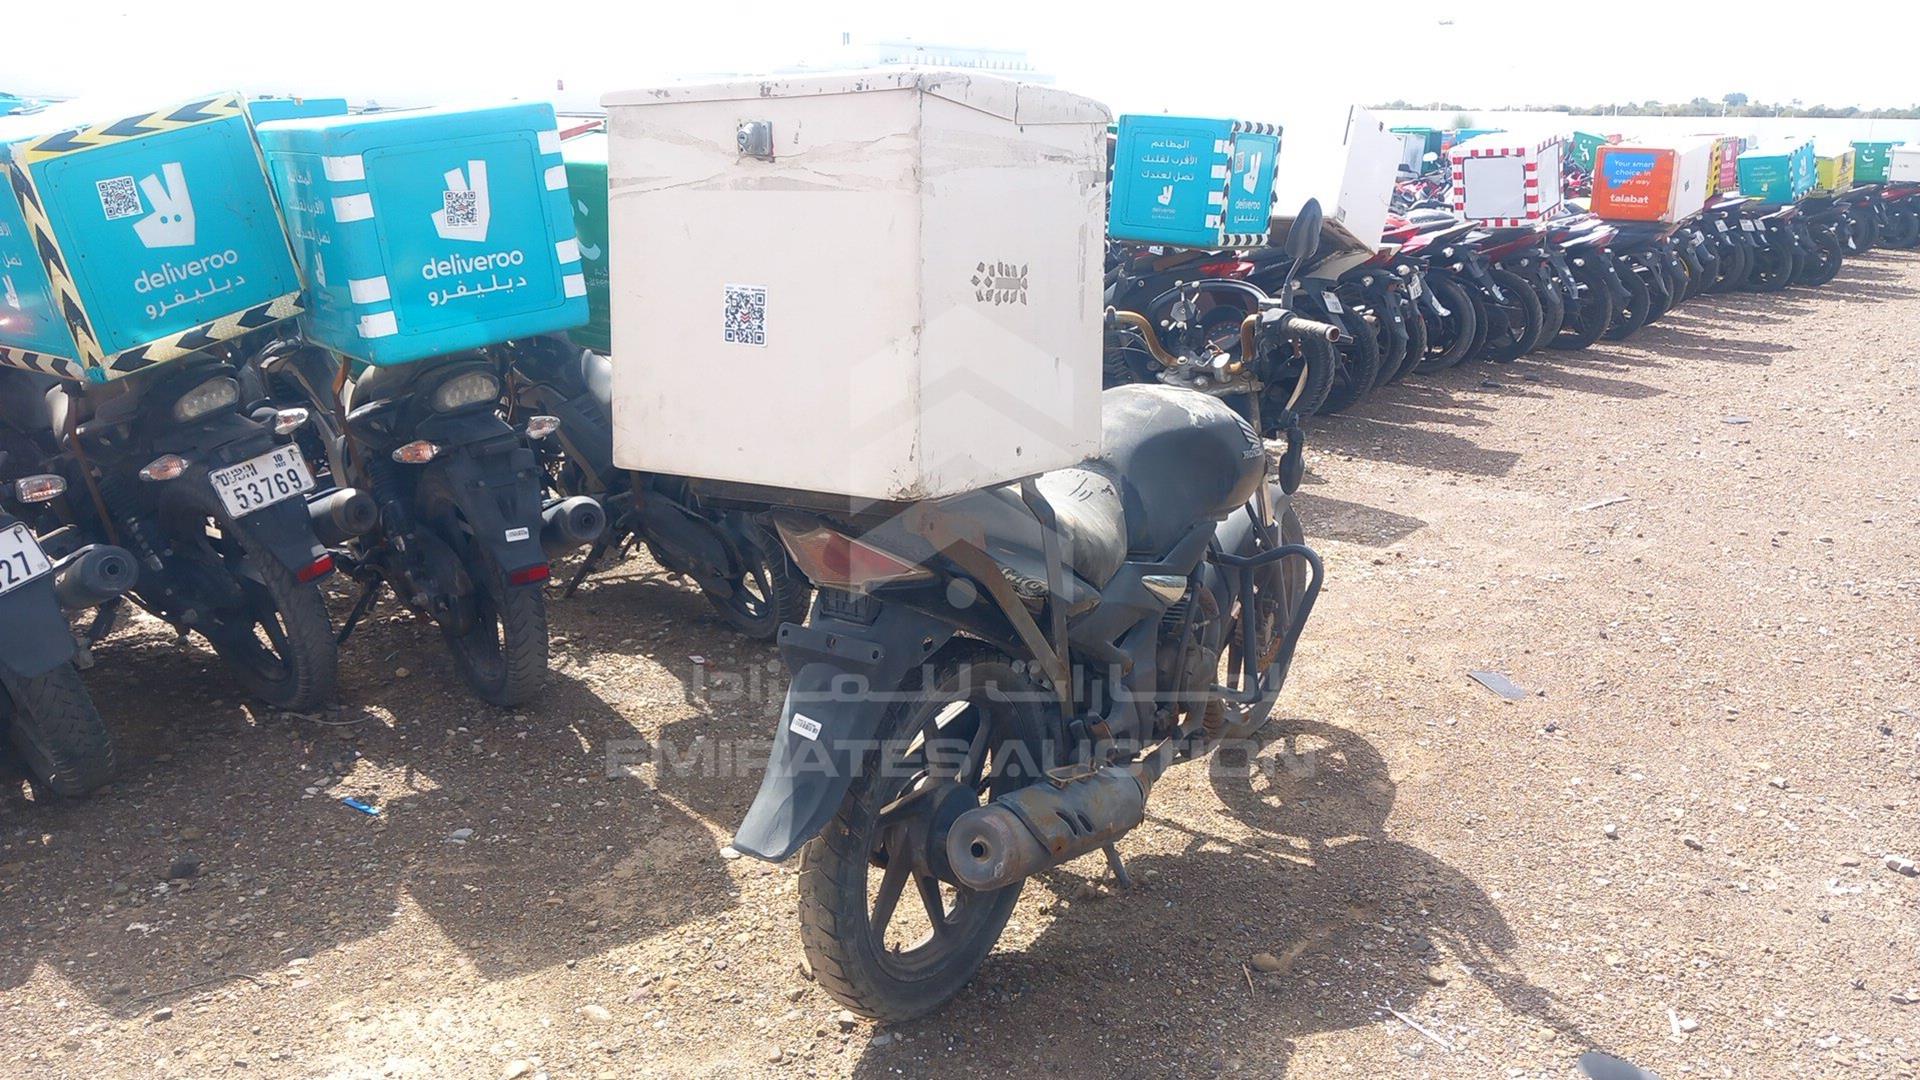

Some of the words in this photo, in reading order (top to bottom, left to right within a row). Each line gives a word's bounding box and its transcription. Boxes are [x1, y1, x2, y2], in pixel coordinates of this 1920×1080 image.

[1614, 159, 1632, 167] Your
[1609, 194, 1649, 204] talabat
[134, 249, 238, 294] deliveroo
[421, 249, 524, 280] deliveroo
[145, 274, 246, 320] ديليفرو
[428, 275, 528, 306] ديليفرو
[233, 468, 302, 510] 53769
[0, 551, 31, 590] 27
